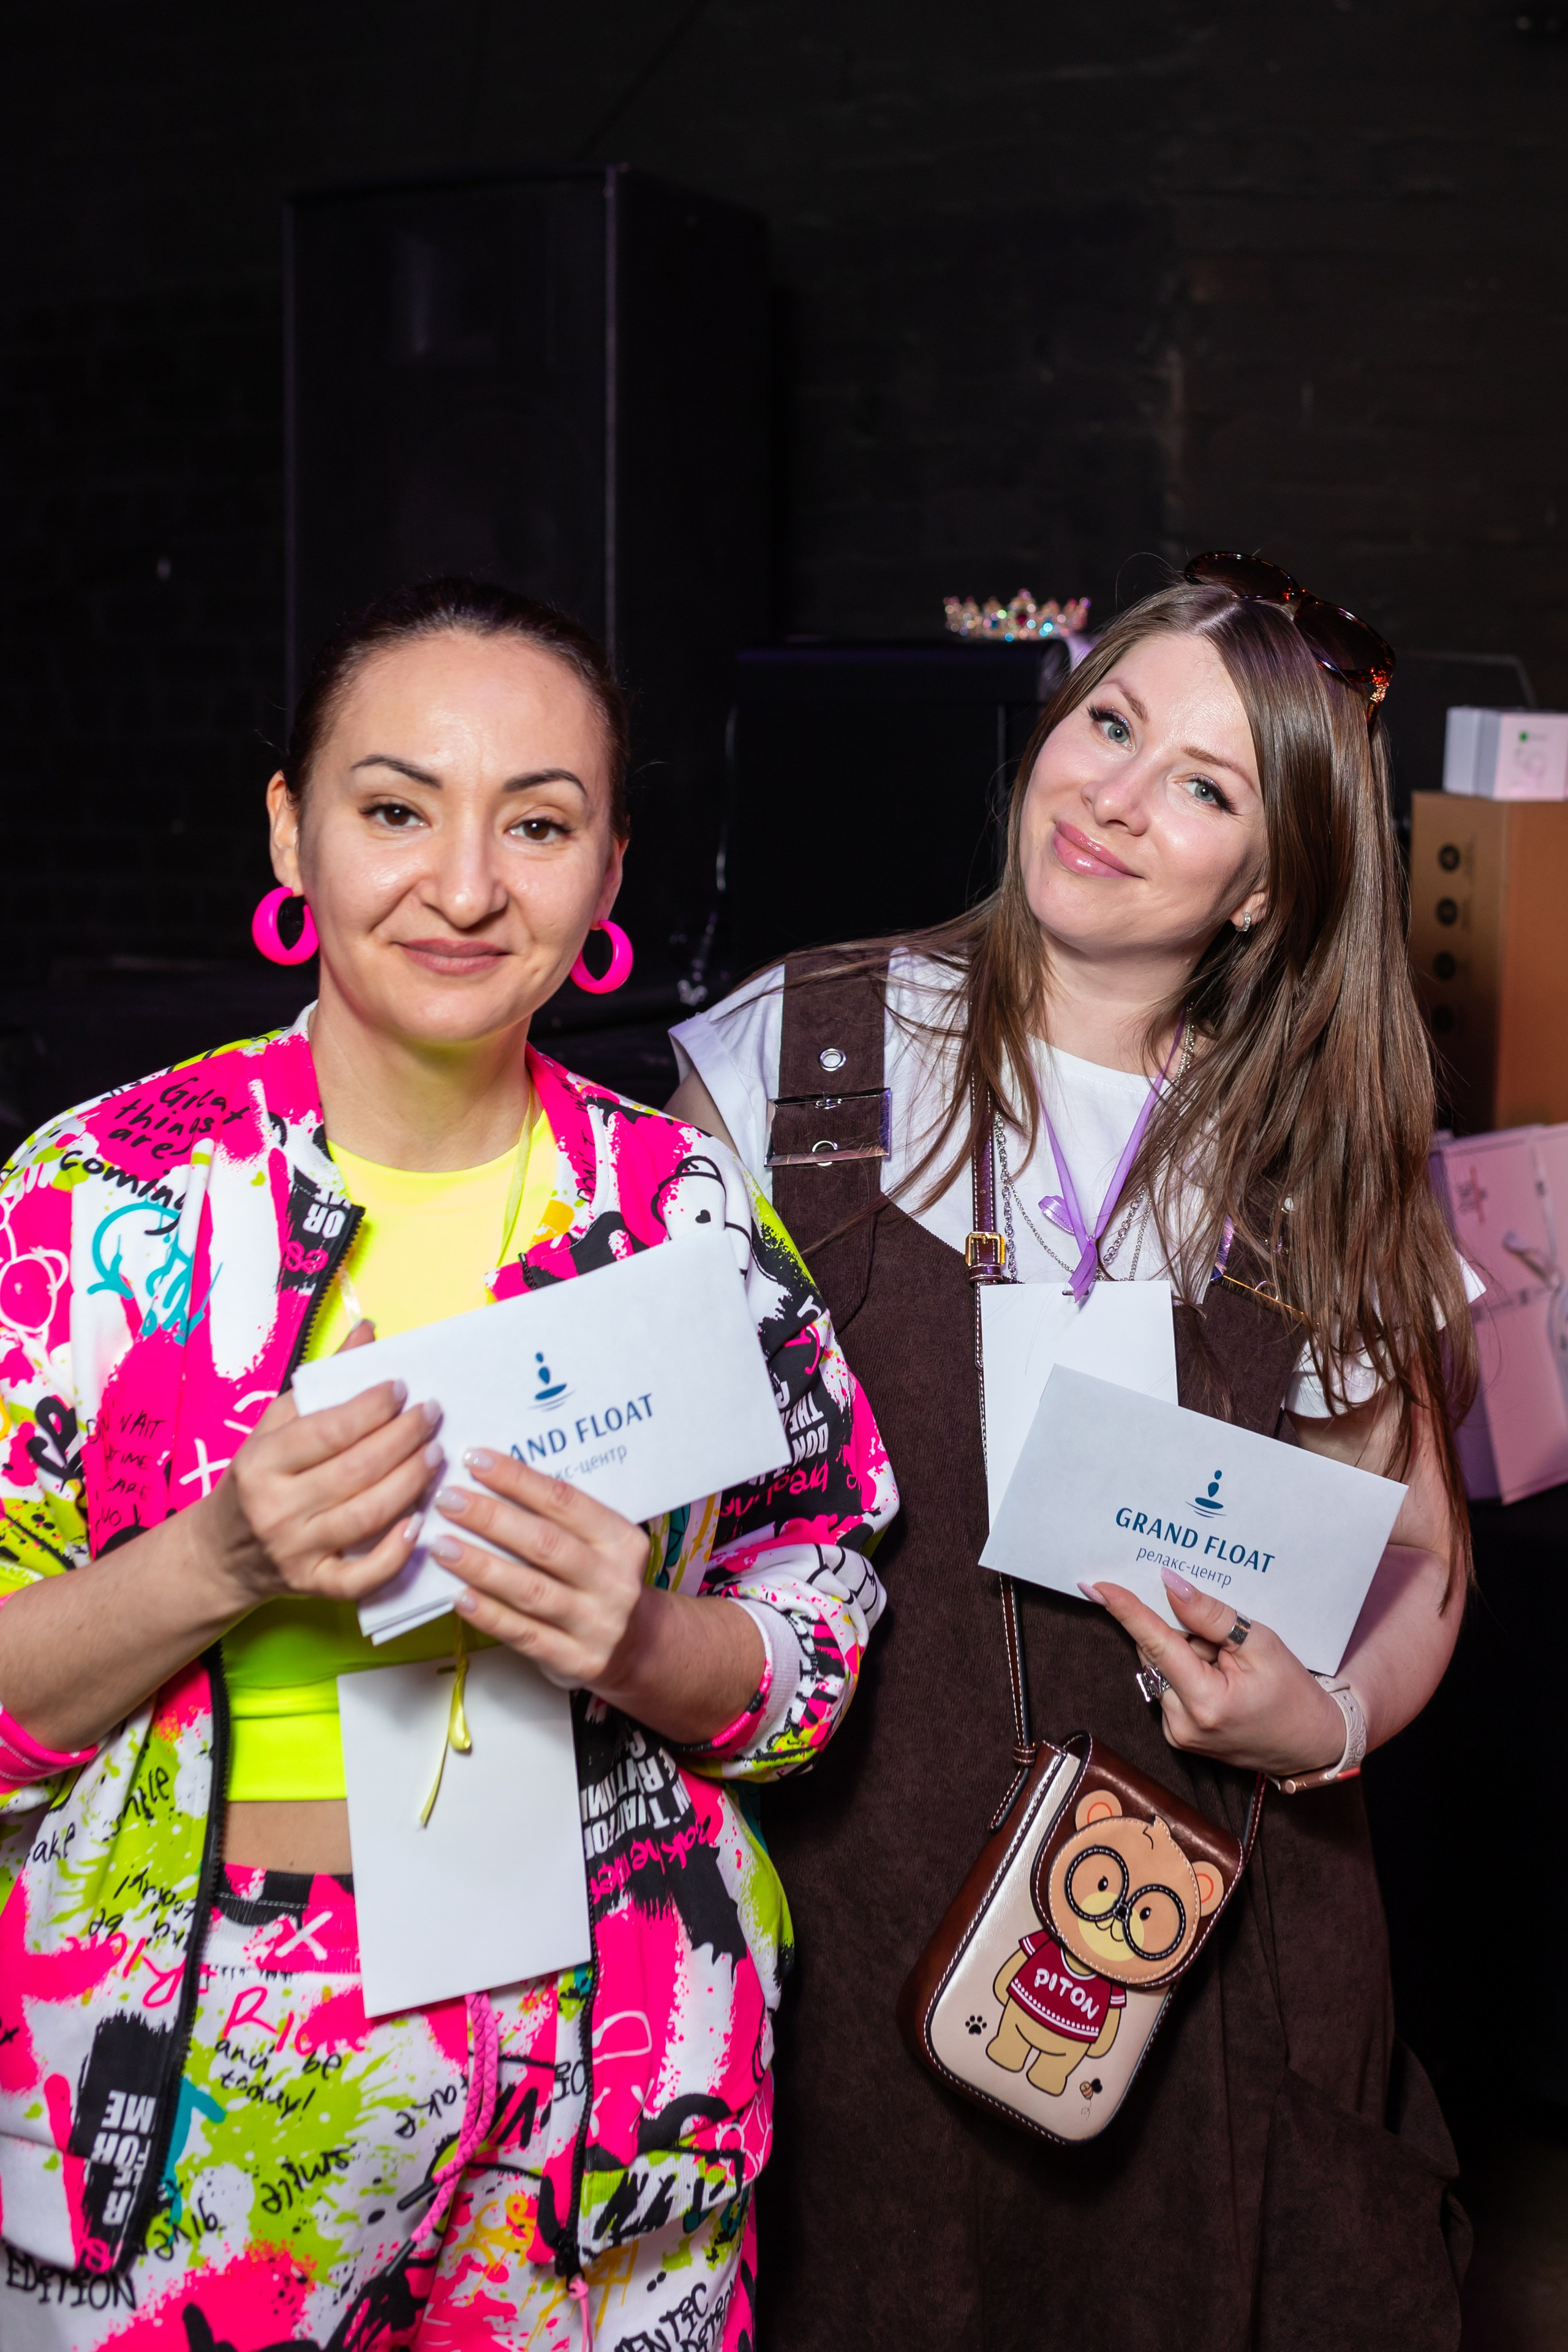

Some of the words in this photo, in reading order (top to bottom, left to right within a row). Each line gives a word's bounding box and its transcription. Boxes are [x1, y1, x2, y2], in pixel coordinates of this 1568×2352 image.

[108, 1128, 174, 1159] are
[114, 1098, 215, 1156] things
[510, 1428, 567, 1466] AND
[575, 1392, 653, 1444] FLOAT
[554, 1443, 628, 1480] кс-центр
[1115, 1507, 1199, 1549] GRAND
[1203, 1535, 1276, 1574] FLOAT
[1136, 1547, 1232, 1589] релакс-центр
[1034, 1967, 1100, 2021] PITON
